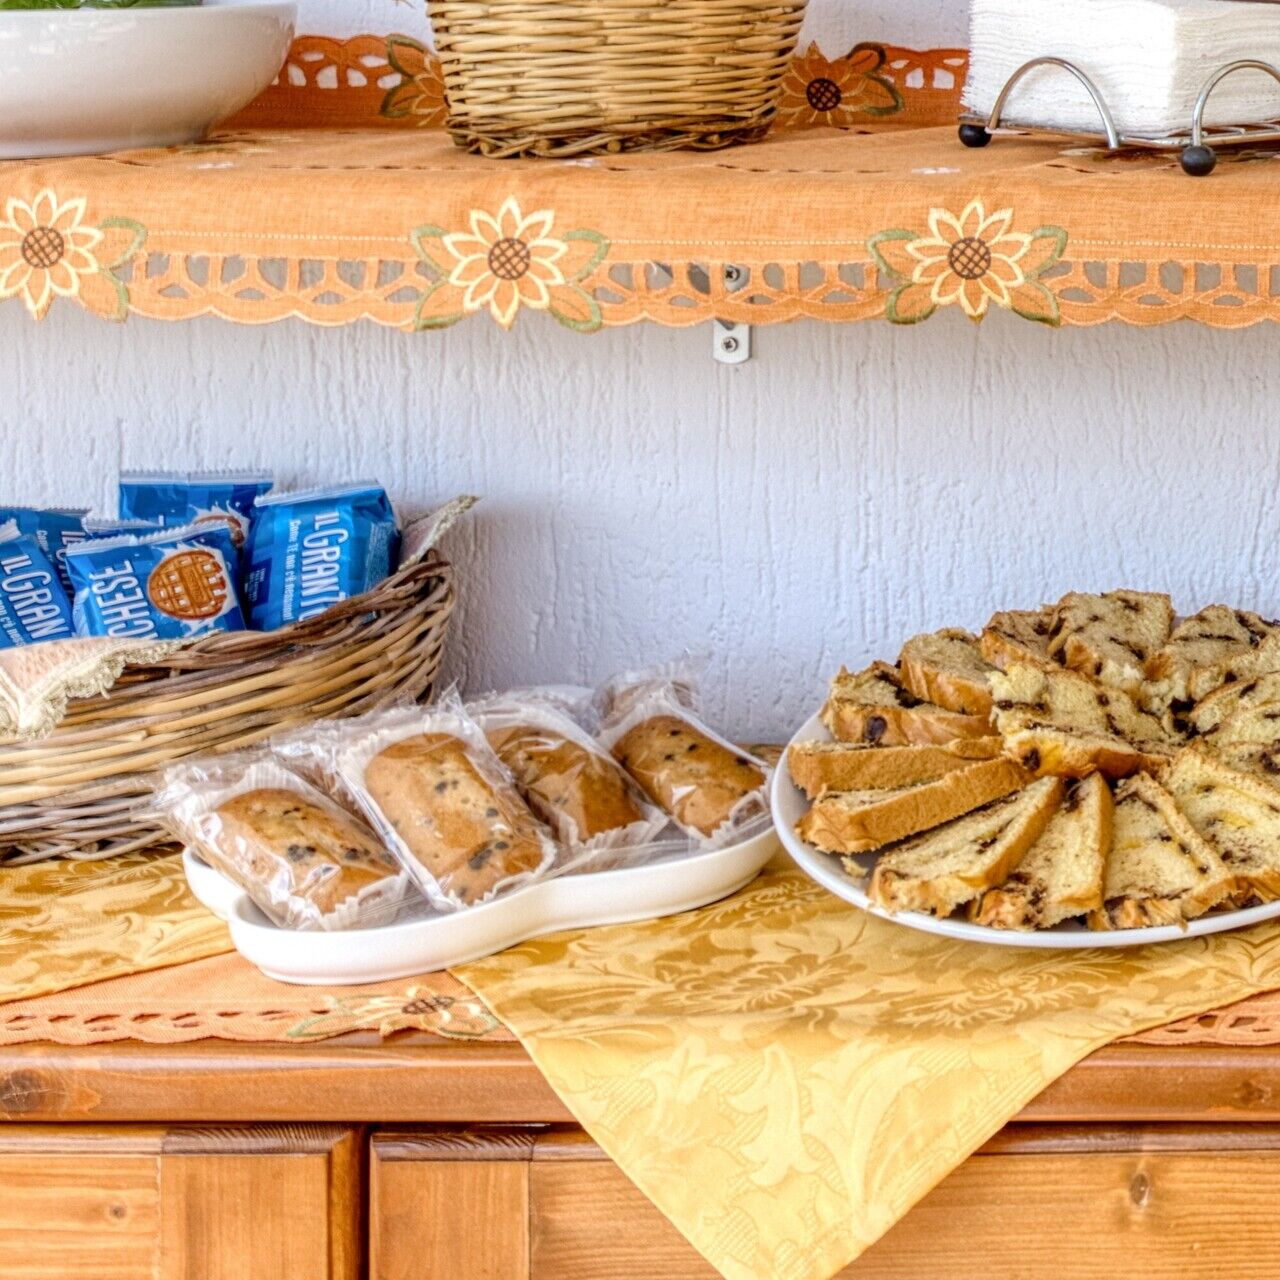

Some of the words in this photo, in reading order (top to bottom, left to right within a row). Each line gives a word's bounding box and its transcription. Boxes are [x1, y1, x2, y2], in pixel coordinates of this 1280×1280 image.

[314, 511, 340, 531] IL
[1, 554, 33, 575] IL
[1, 571, 75, 639] GRAN
[88, 560, 159, 639] CHESE
